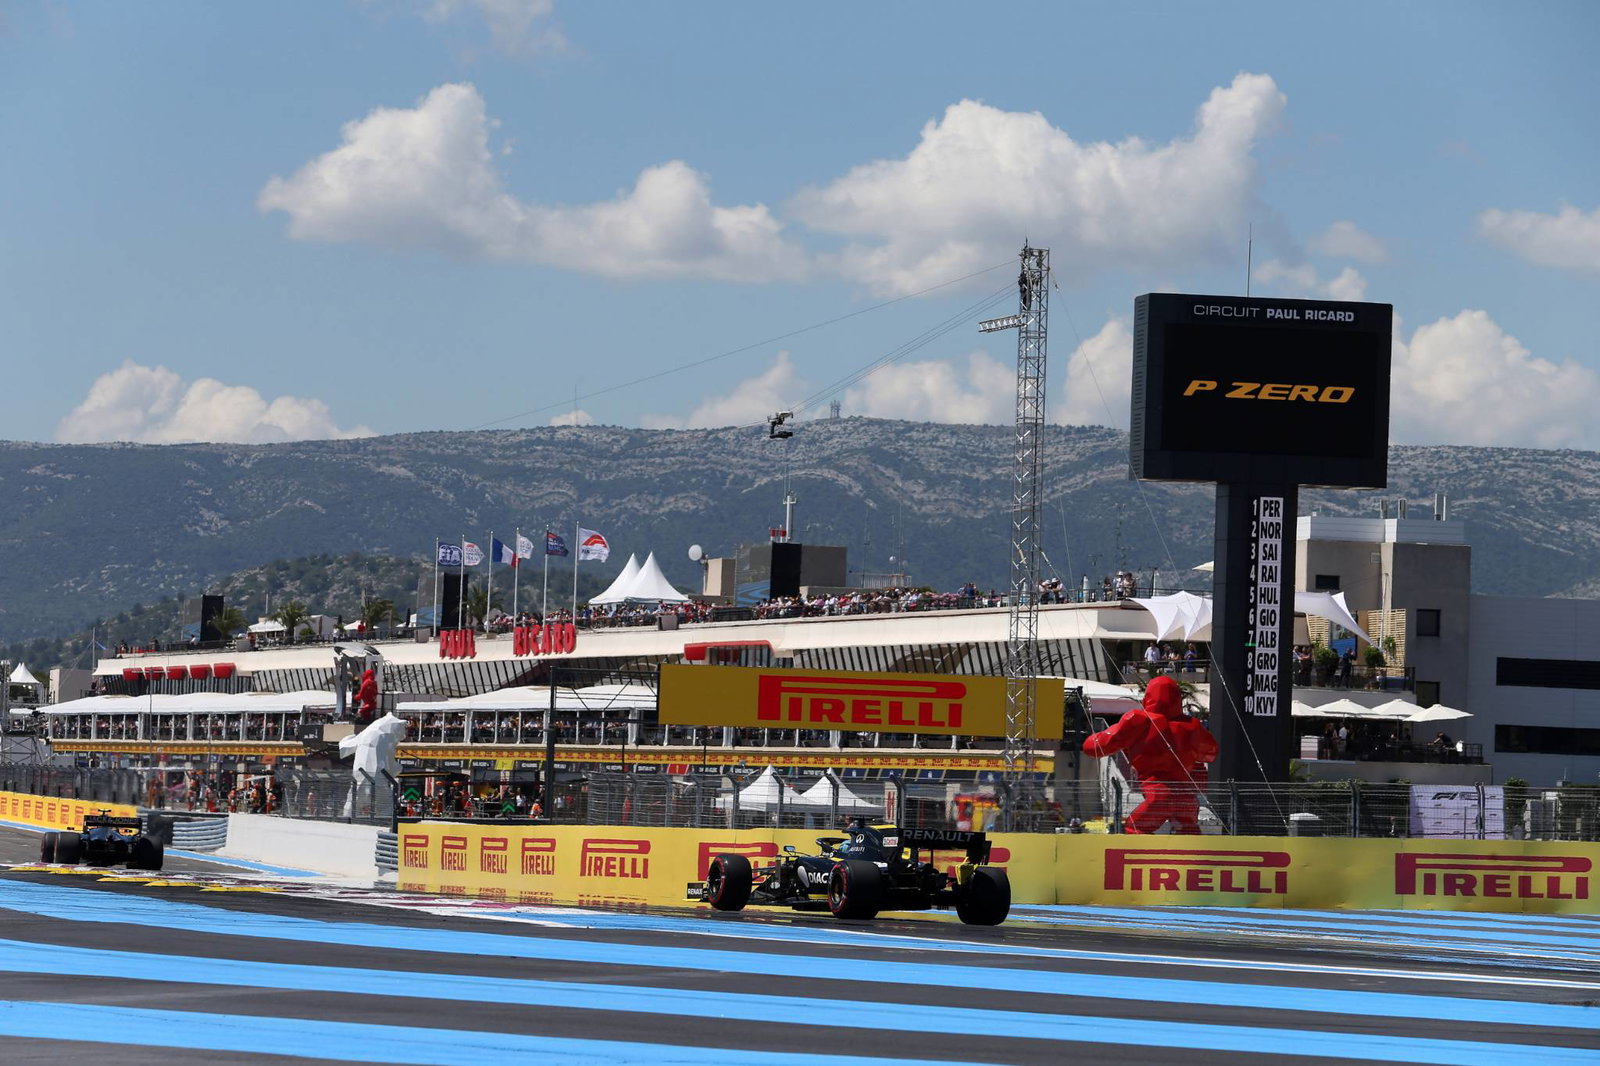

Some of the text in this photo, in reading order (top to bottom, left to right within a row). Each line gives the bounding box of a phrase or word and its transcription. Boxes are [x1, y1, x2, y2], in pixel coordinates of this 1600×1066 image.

[1193, 304, 1355, 322] CIRCUIT PAUL RICARD
[1183, 380, 1355, 403] P ZERO
[1253, 499, 1280, 517] 1 PER
[1251, 521, 1281, 539] 2 NOR
[1250, 543, 1277, 560] 3 SAI
[1249, 565, 1277, 582] 4 RAI
[1249, 586, 1278, 604] 5 HUL
[1248, 608, 1277, 626] 6 GIO
[439, 623, 577, 658] PAUL RICARD
[1248, 630, 1277, 648] 7 ALB
[1247, 652, 1277, 670] 8 GRO
[1246, 674, 1277, 692] 9 MAG
[757, 674, 967, 728] PIRELLI
[1244, 696, 1275, 714] 10 KVY
[903, 829, 975, 842] RENAULT
[403, 834, 429, 869] PIRELLI
[441, 836, 467, 872] PIRELLI
[480, 837, 508, 874] PIRELLI
[521, 838, 556, 875] PIRELLI
[580, 838, 651, 879] PIRELLI
[808, 872, 829, 884] DIAC
[1104, 848, 1291, 894] PIRELLI
[1395, 853, 1592, 899] PIRELLI
